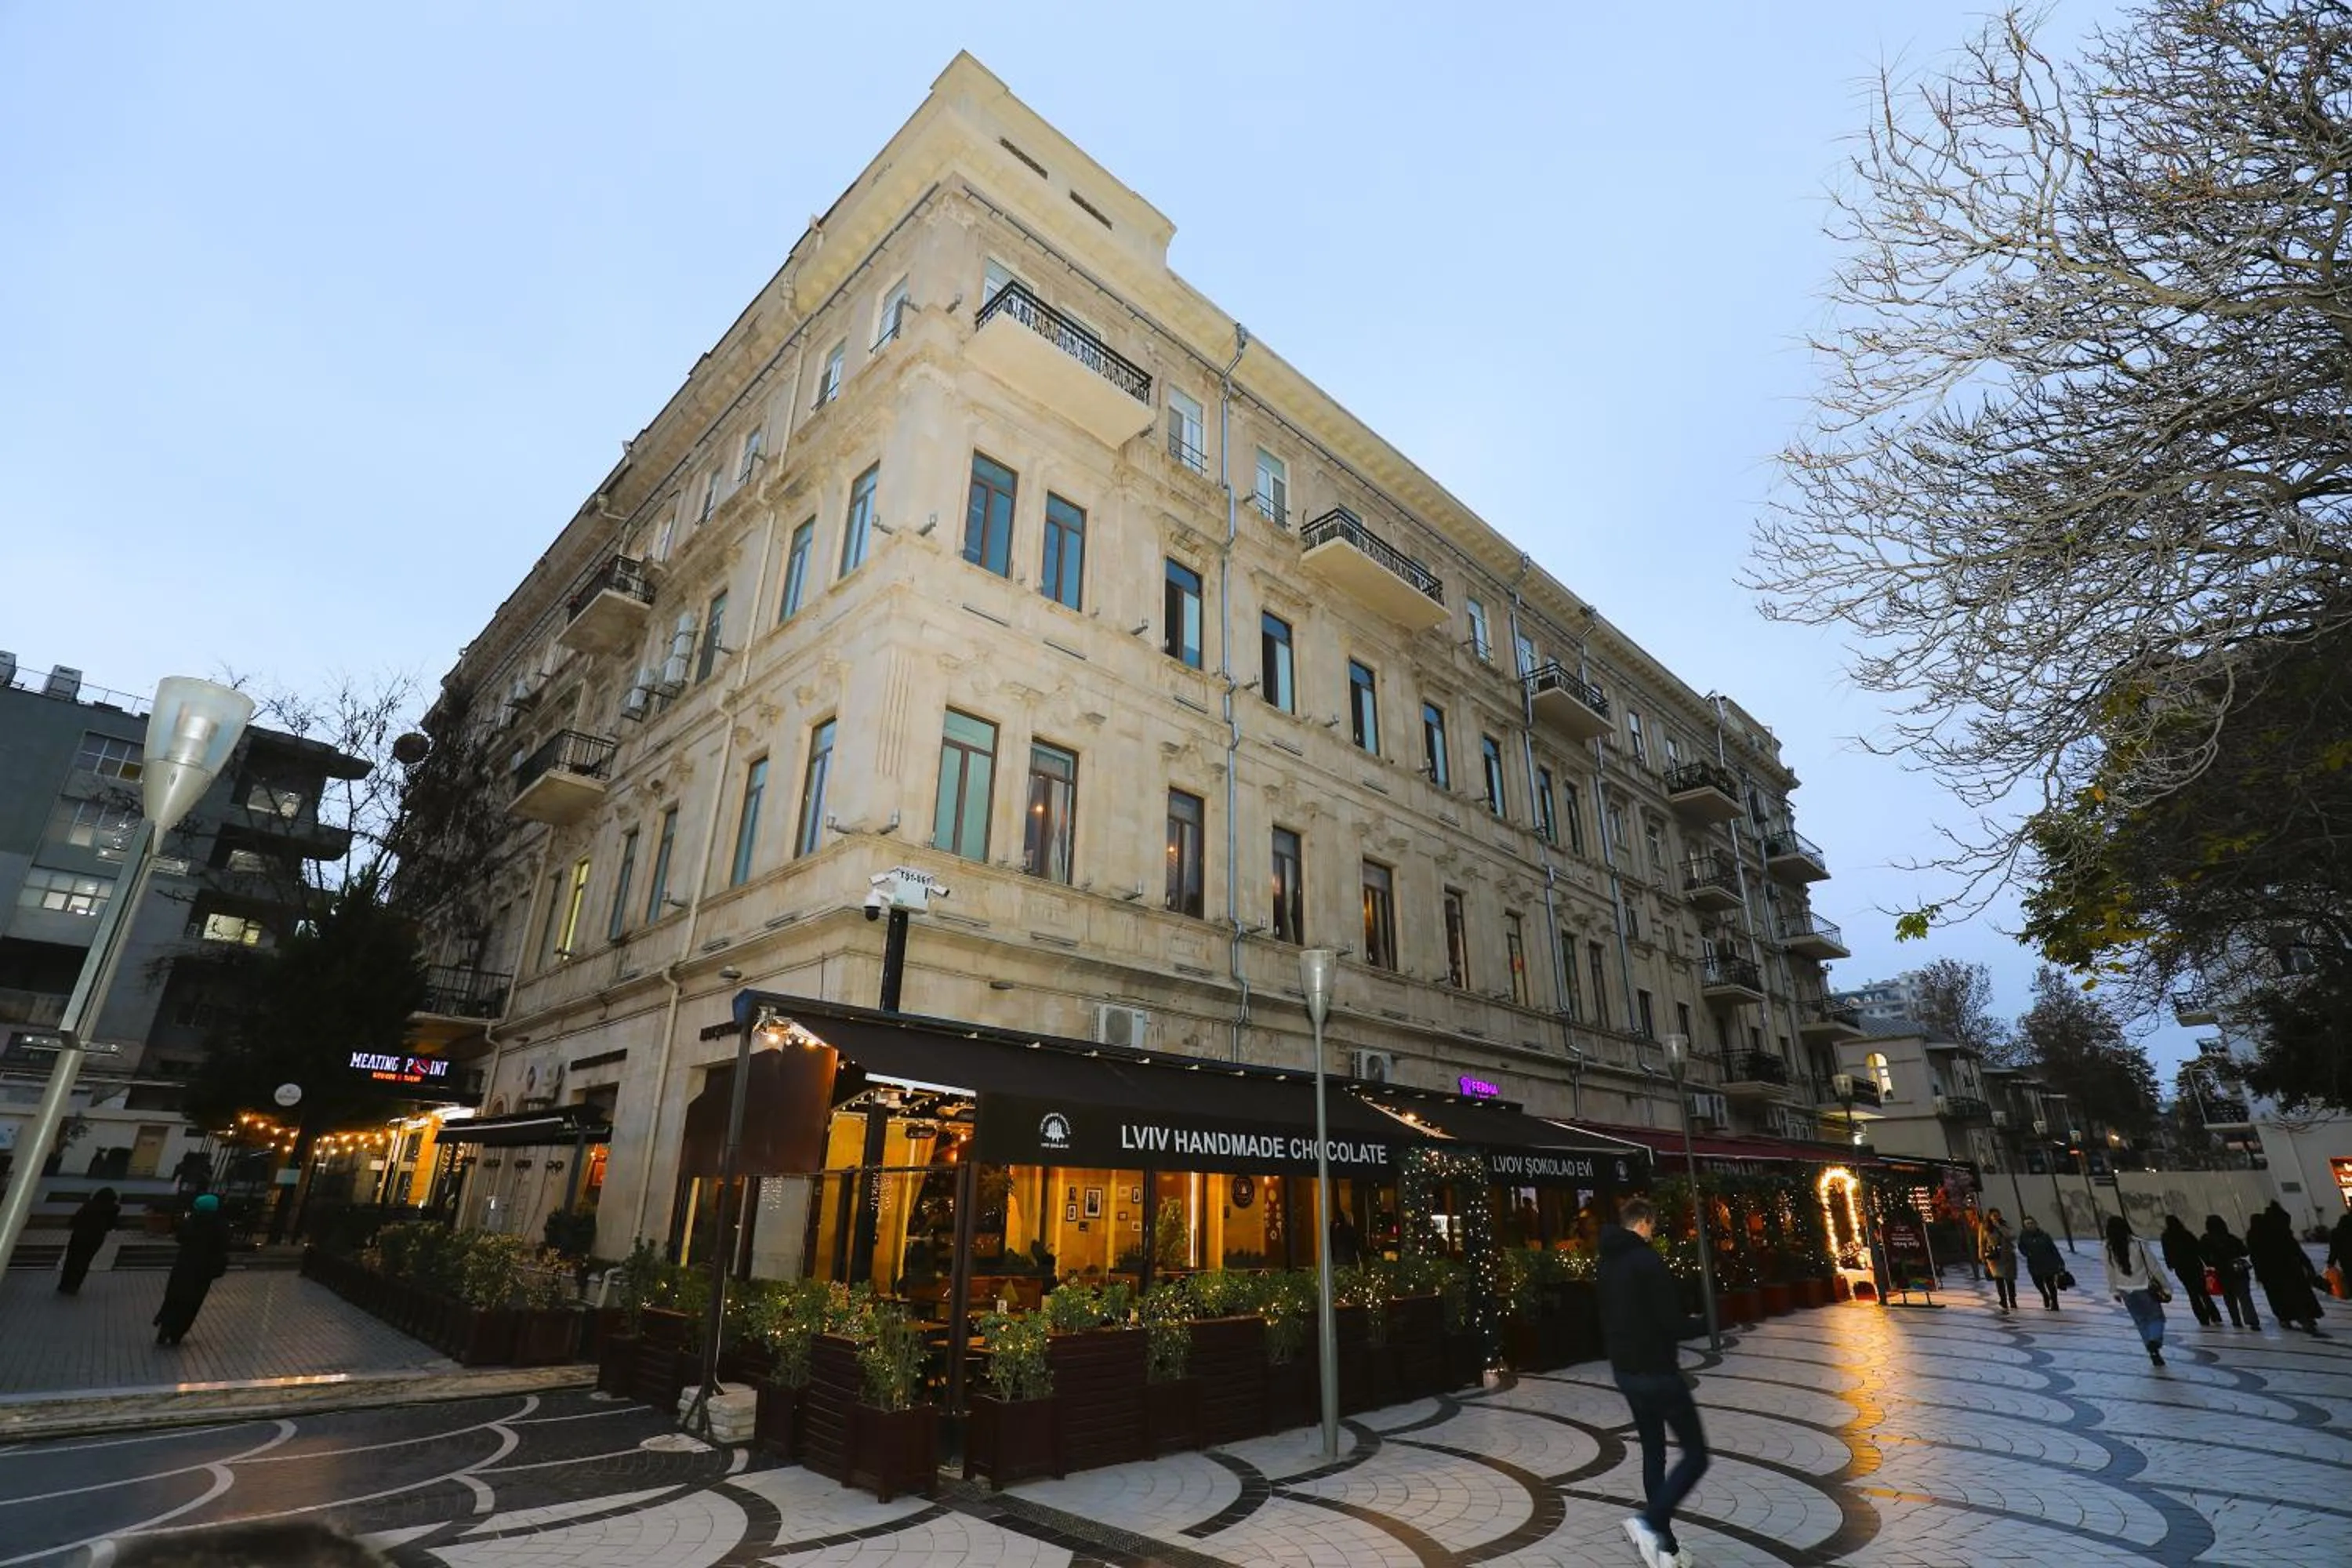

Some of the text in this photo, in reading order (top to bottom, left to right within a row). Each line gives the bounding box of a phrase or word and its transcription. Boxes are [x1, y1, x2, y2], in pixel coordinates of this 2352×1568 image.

[350, 1051, 400, 1072] MEATING
[1121, 1125, 1169, 1151] LVIV
[1174, 1129, 1286, 1159] HANDMADE
[1493, 1156, 1522, 1174] LVOV
[1526, 1157, 1574, 1178] ŞOKOLAD
